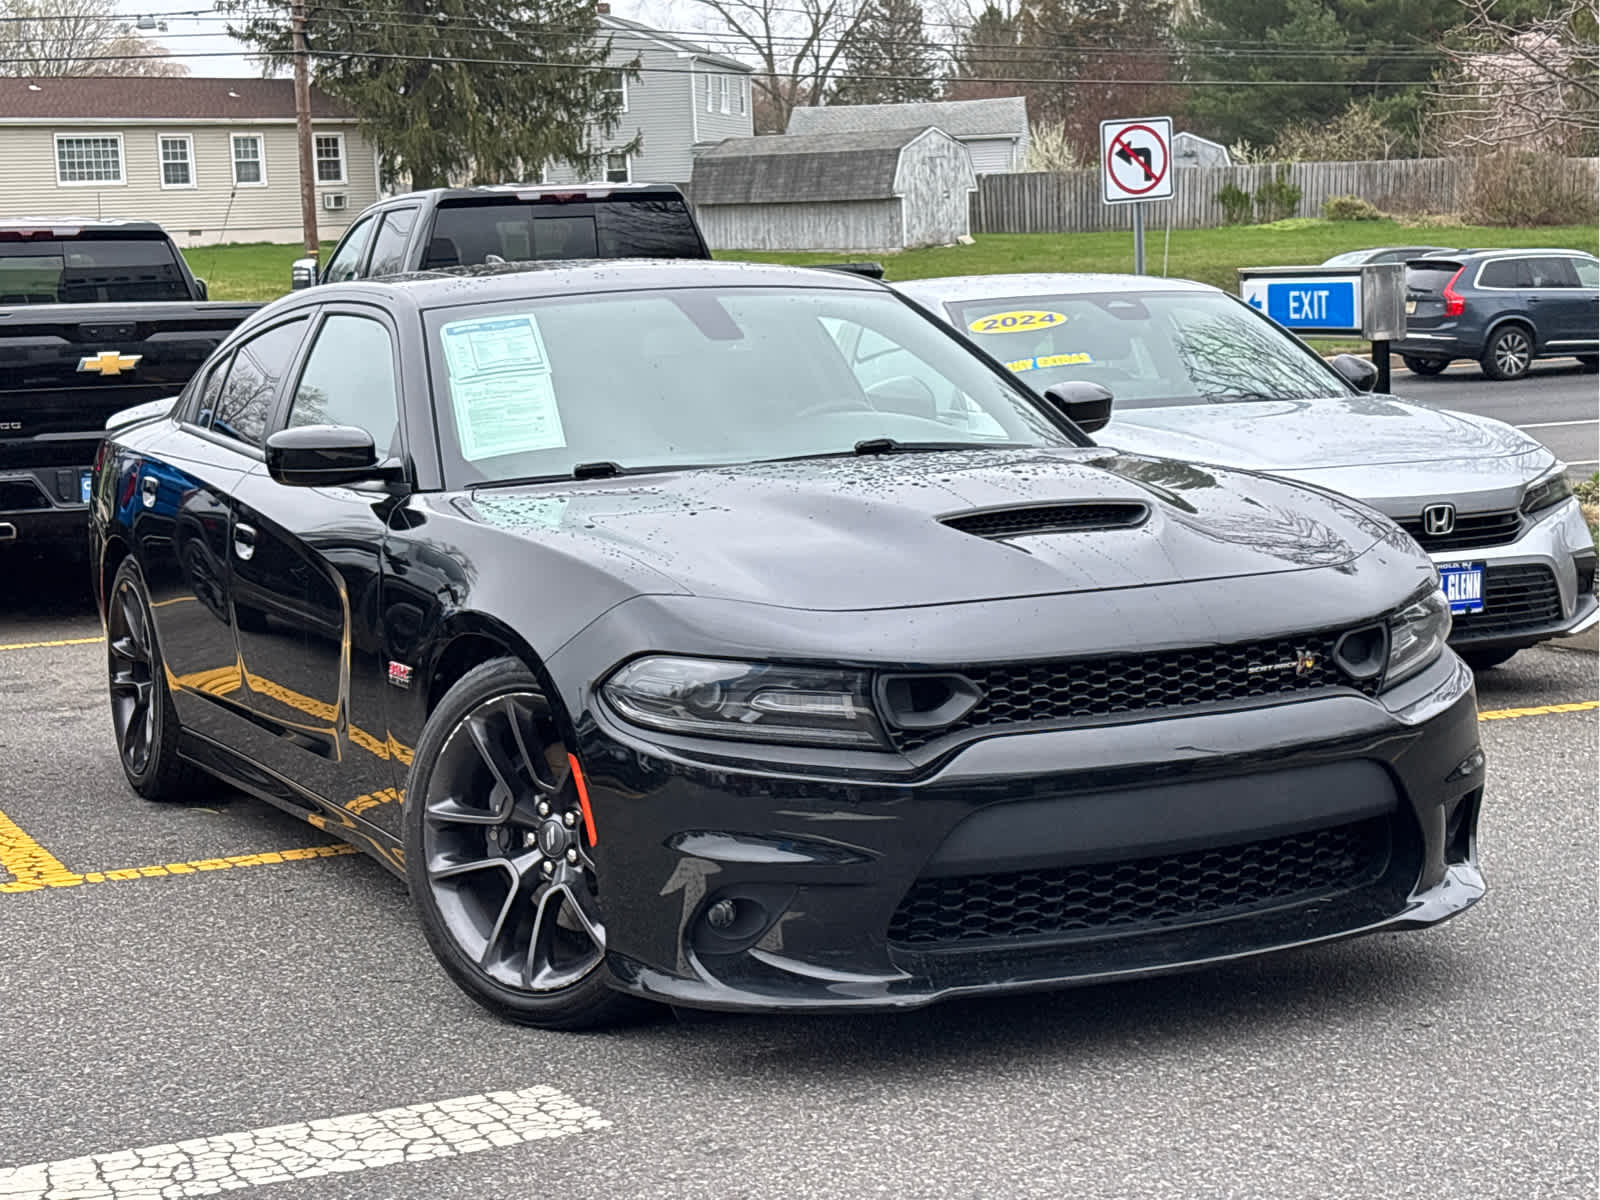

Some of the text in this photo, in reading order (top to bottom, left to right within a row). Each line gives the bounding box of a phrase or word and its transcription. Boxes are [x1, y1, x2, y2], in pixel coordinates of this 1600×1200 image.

[1288, 290, 1330, 320] EXIT
[982, 313, 1057, 331] 2024
[1447, 572, 1481, 601] GLENN
